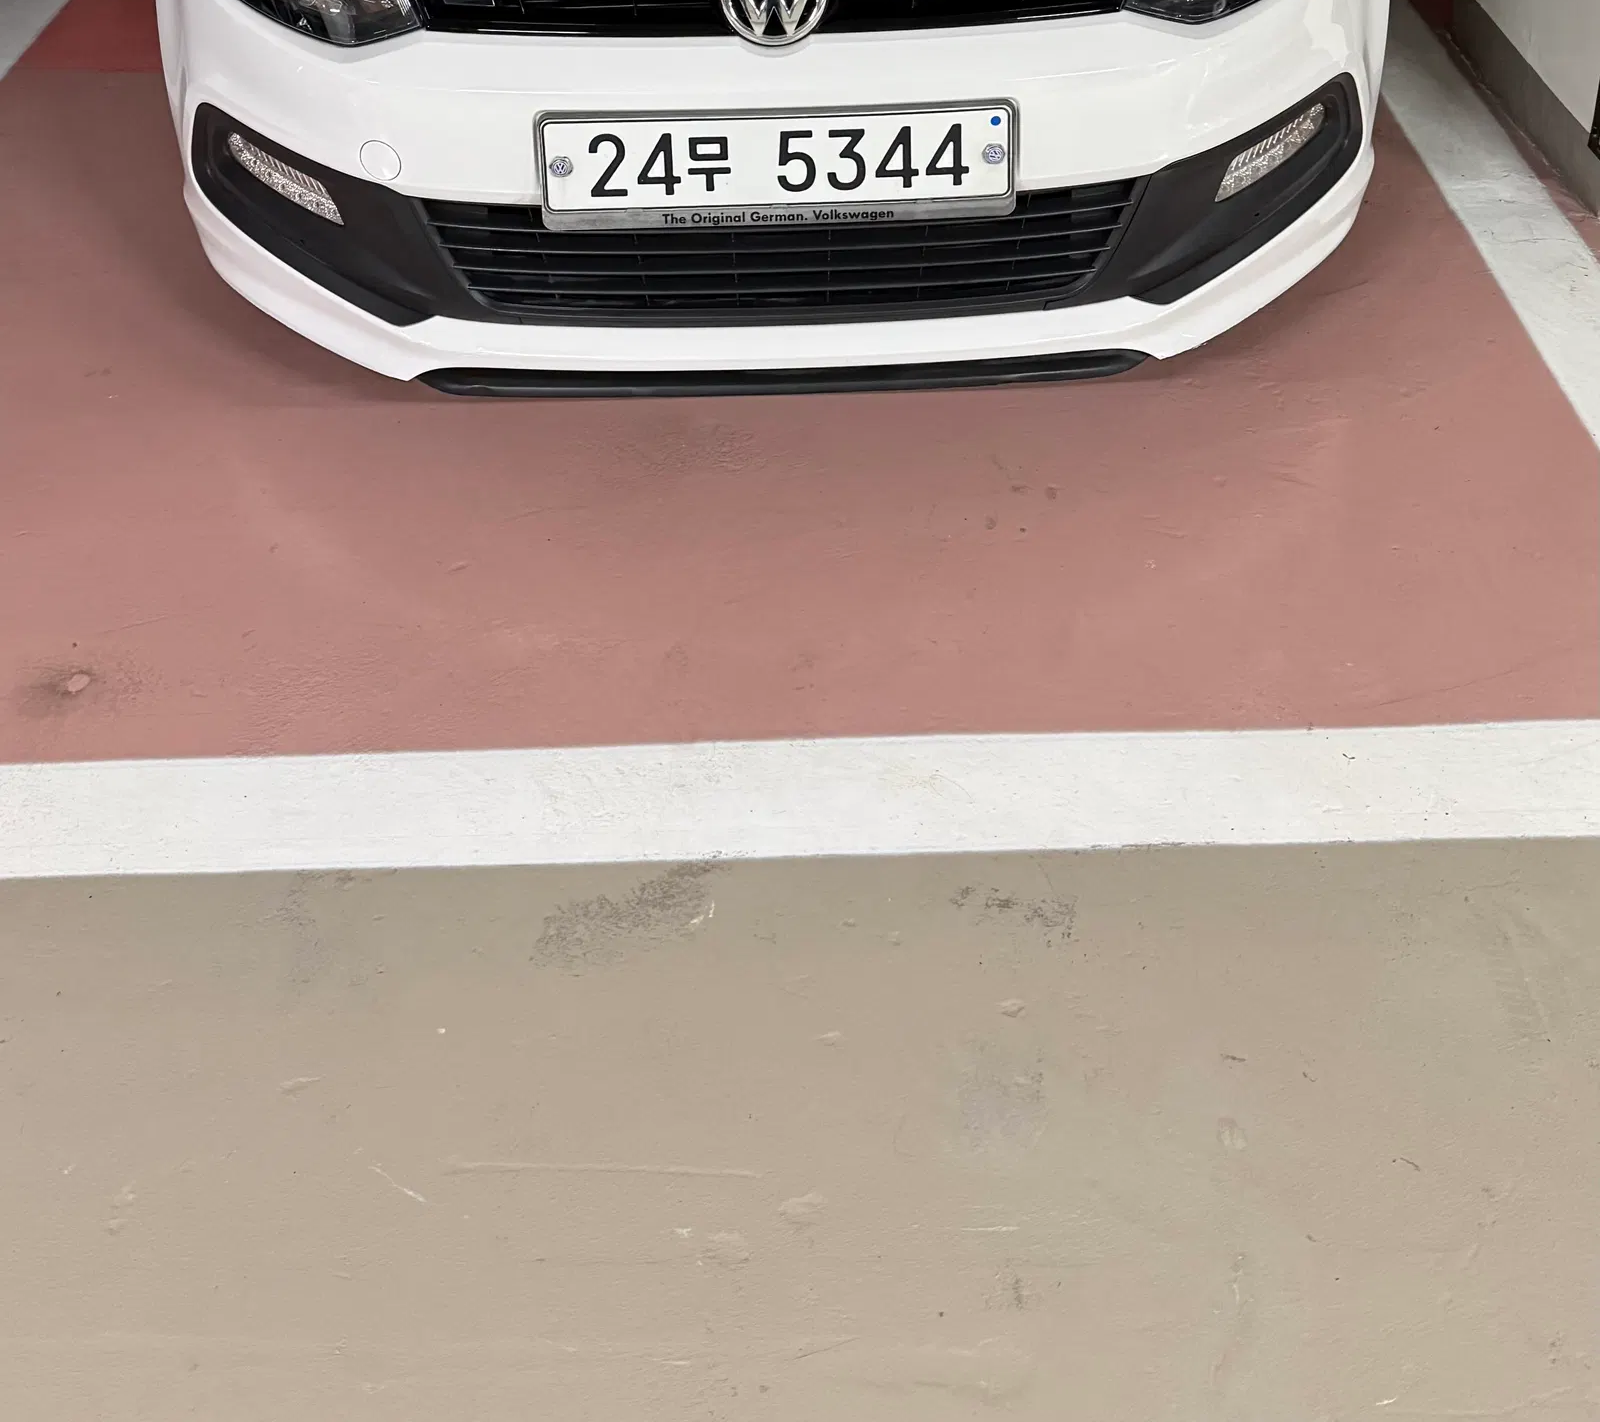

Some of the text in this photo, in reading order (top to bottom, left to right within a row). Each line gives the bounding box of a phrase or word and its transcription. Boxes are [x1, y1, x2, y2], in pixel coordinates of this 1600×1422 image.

[588, 123, 970, 197] 24무 5344
[662, 209, 894, 226] The Original German. Volkswagen
